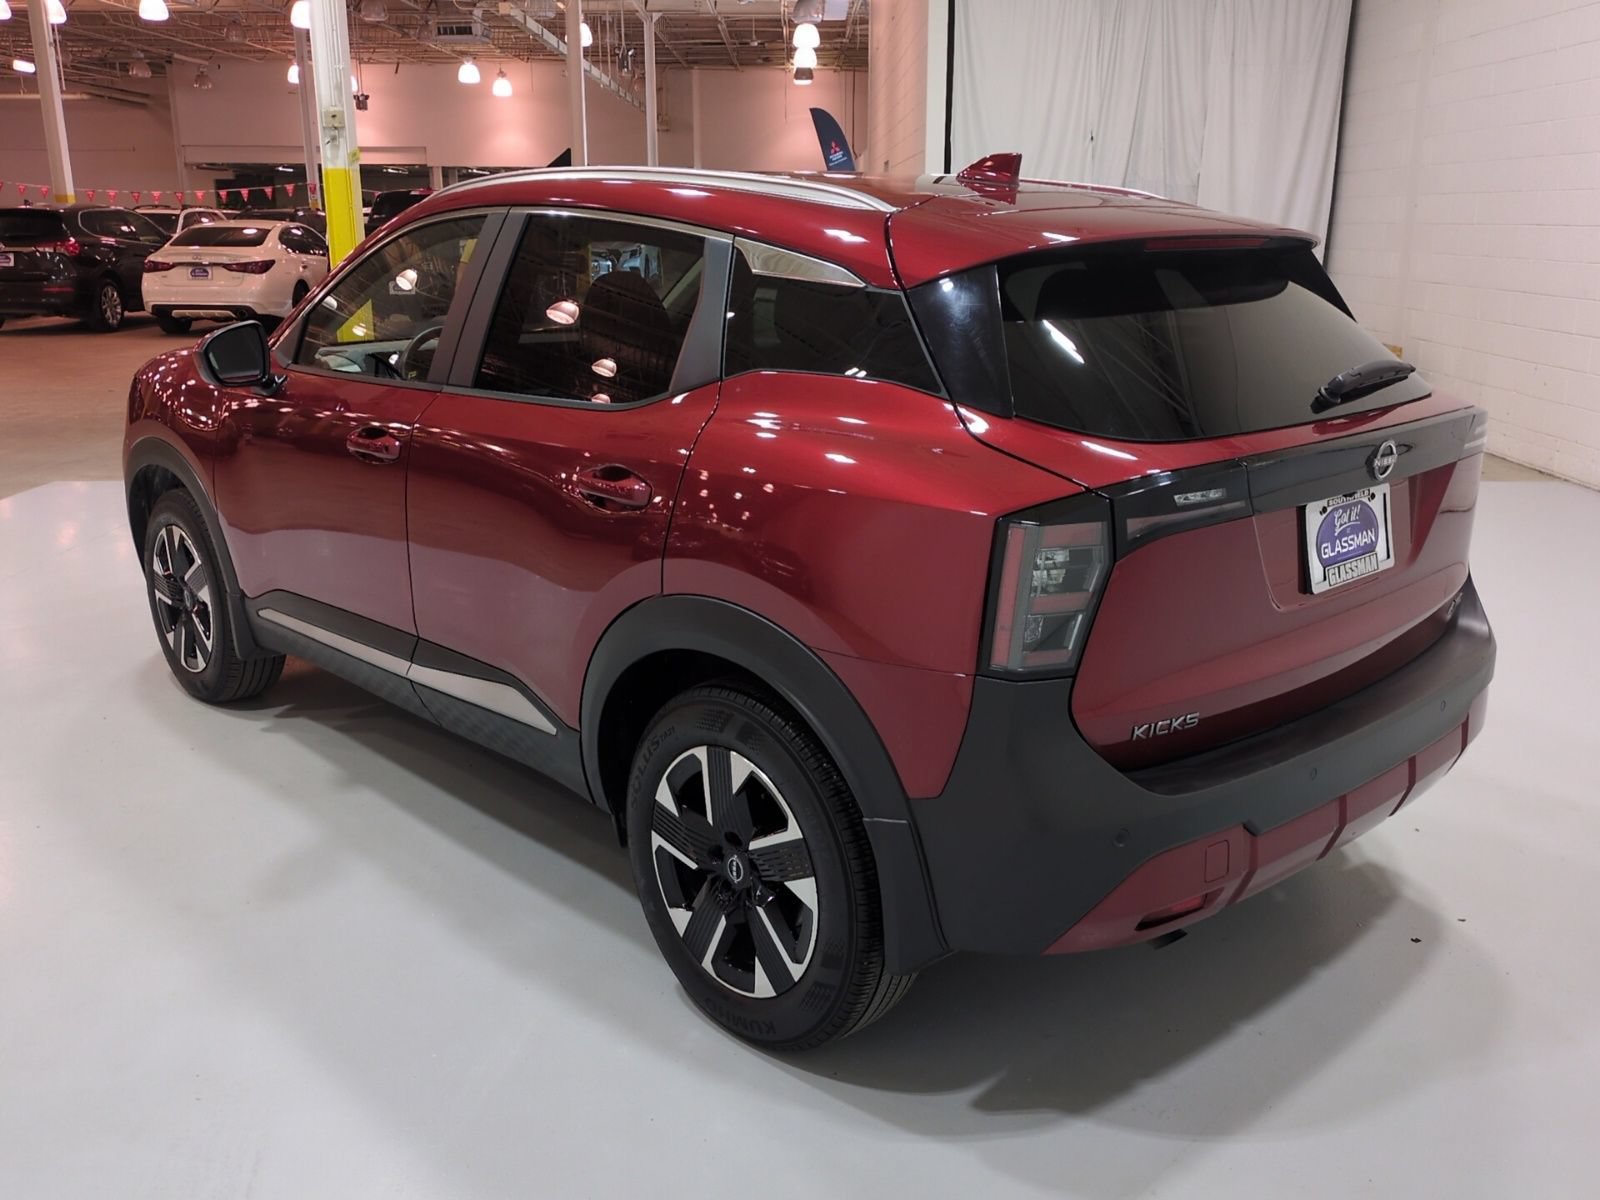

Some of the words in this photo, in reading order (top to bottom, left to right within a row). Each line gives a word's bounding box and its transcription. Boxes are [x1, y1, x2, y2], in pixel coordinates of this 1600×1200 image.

[1334, 508, 1350, 527] Got
[1351, 504, 1361, 521] it!
[1321, 528, 1376, 558] GLASSMAN
[1328, 554, 1378, 586] GLASSMAN
[1132, 712, 1200, 740] KICKS
[631, 736, 660, 809] SOLUS
